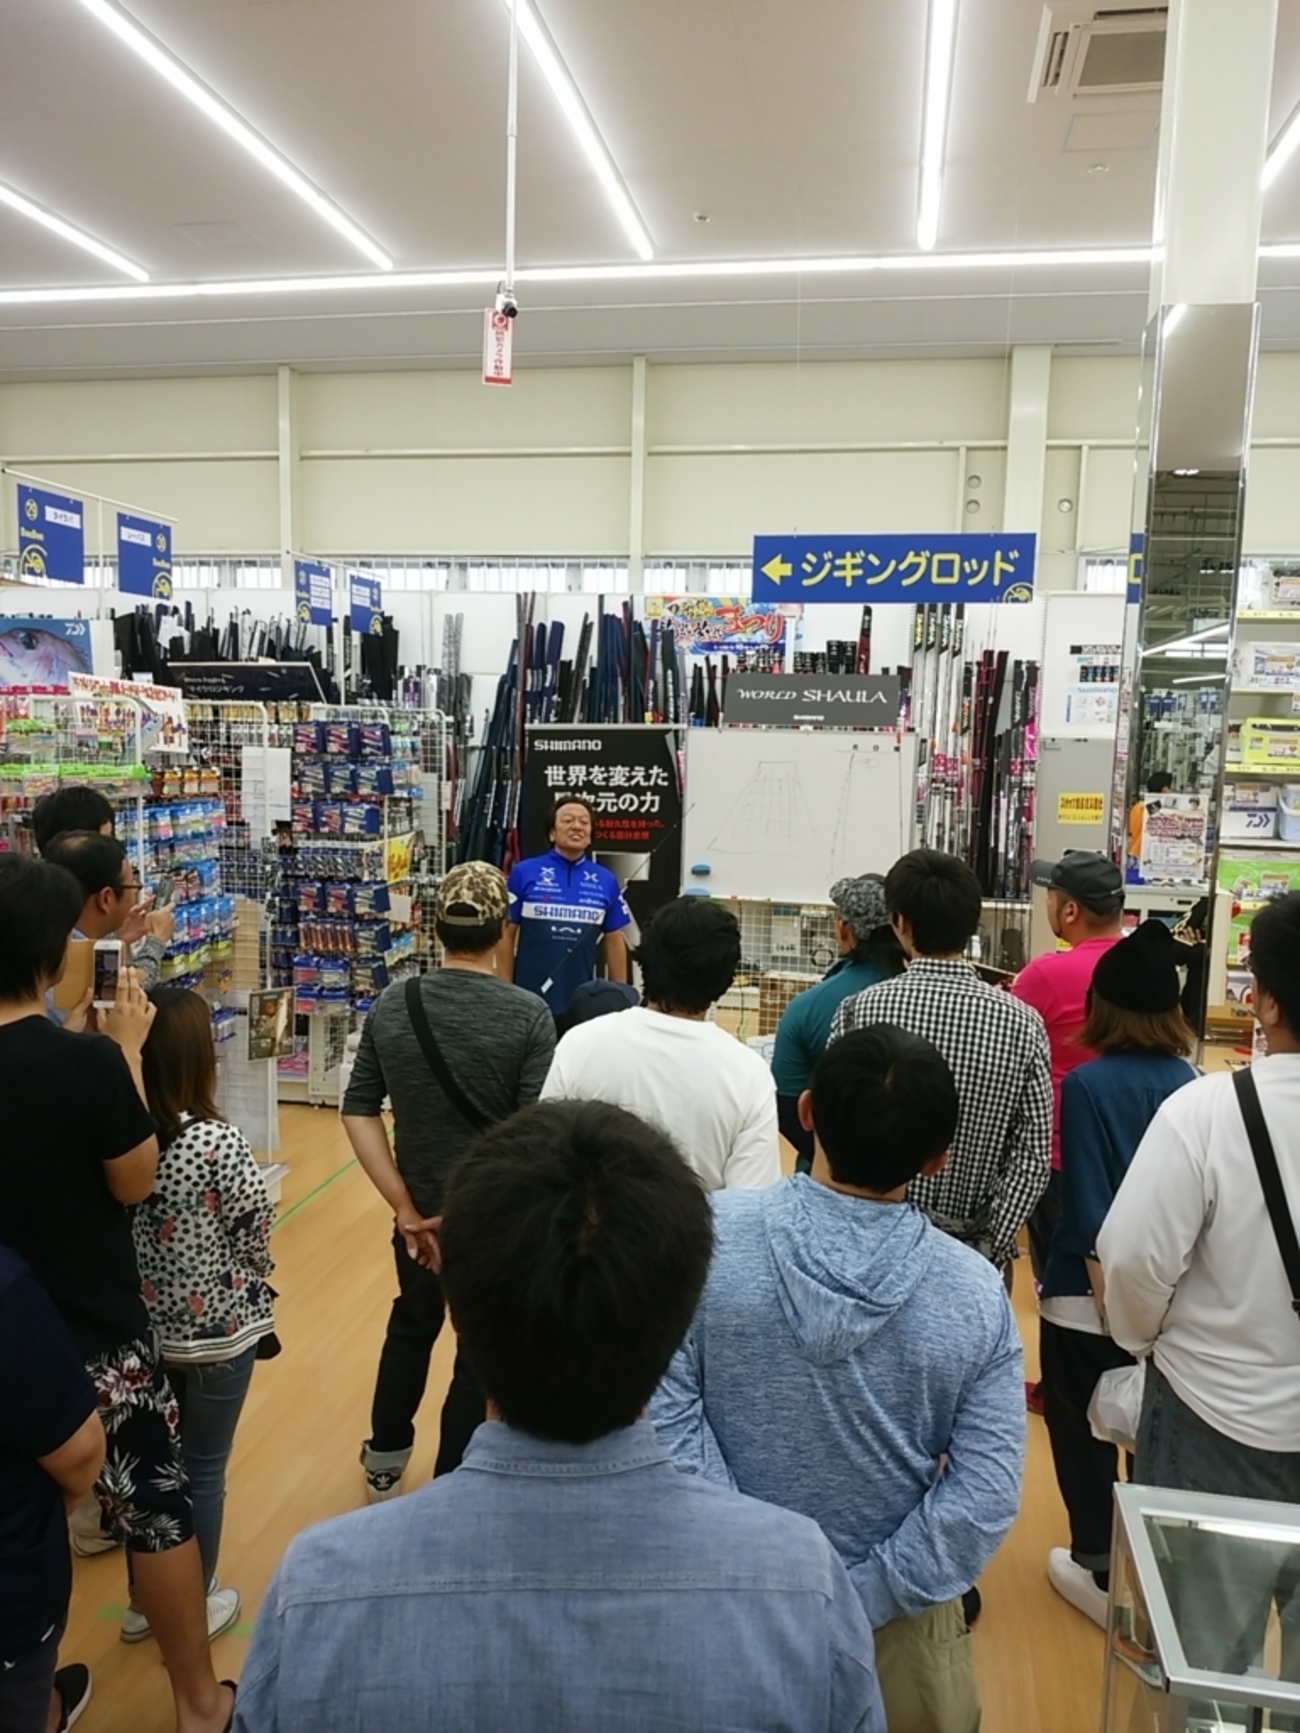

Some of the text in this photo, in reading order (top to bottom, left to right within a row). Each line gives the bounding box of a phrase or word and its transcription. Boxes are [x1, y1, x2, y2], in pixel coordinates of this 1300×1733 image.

[801, 550, 1020, 587] ジギングロッド
[715, 605, 783, 644] まつり
[736, 688, 888, 704] WORLD SHAULA
[533, 739, 602, 751] SHIMANO
[544, 765, 669, 787] 世界を変えた
[533, 905, 601, 921] SHIMANO
